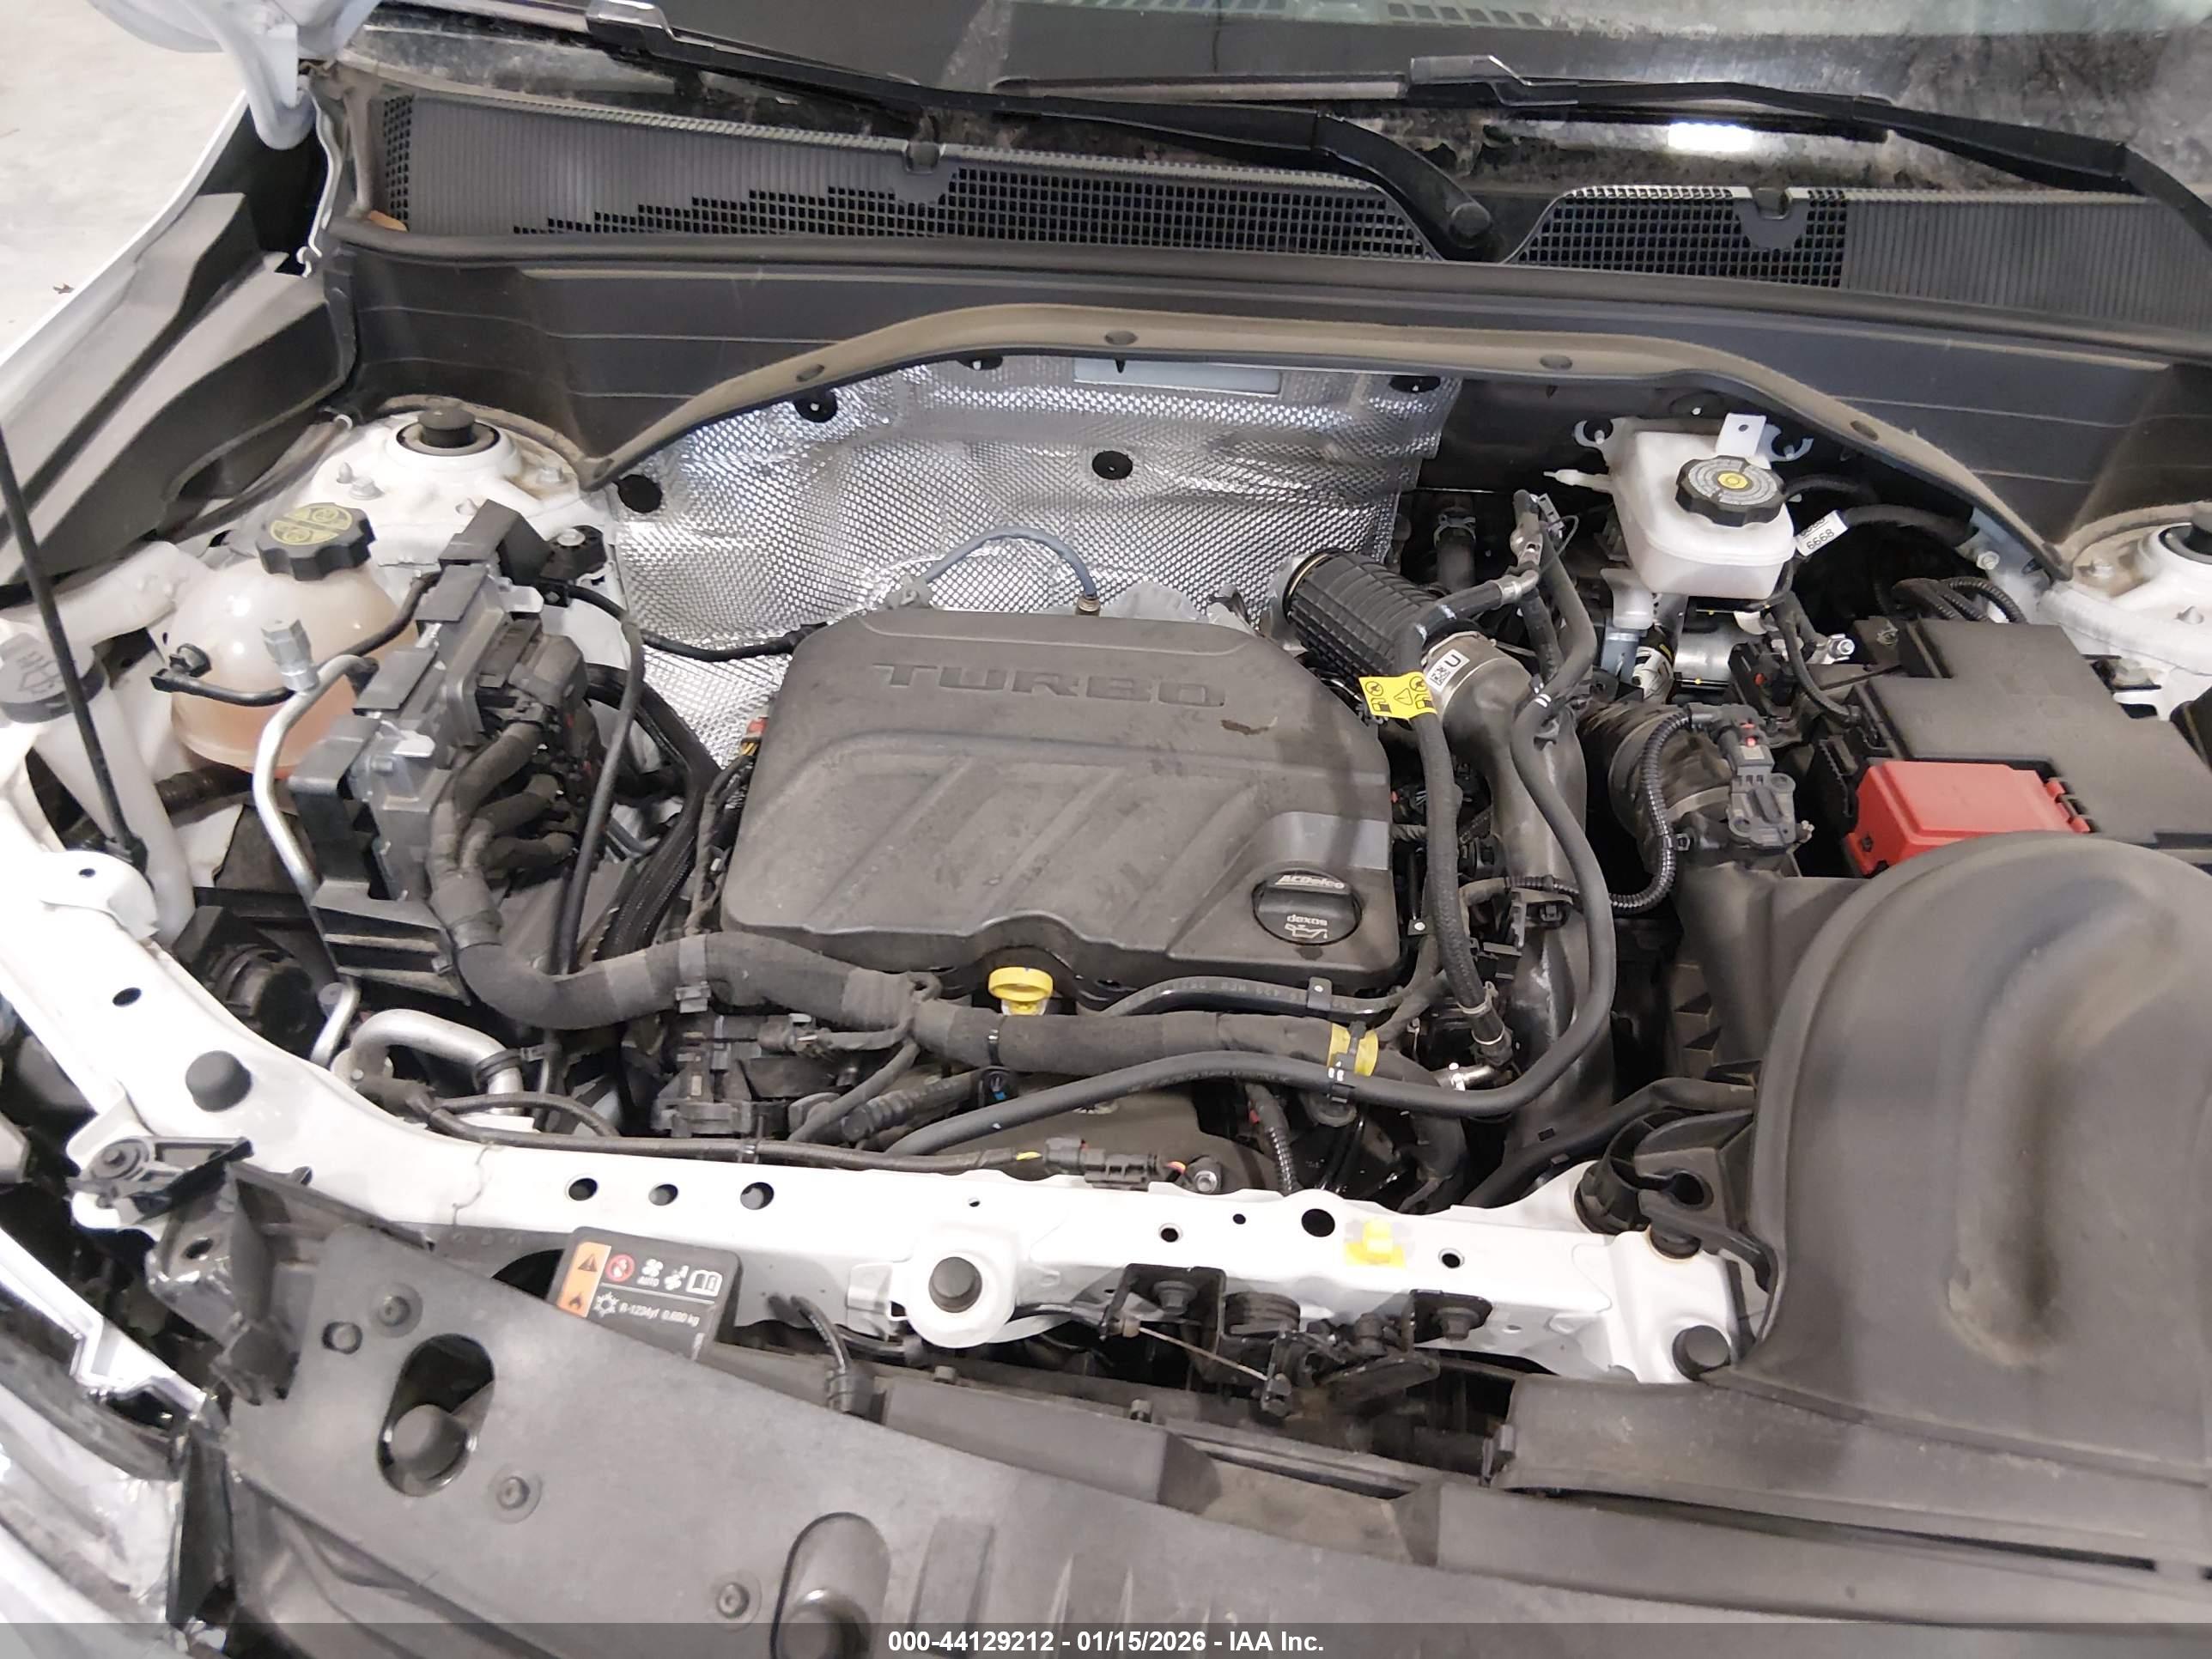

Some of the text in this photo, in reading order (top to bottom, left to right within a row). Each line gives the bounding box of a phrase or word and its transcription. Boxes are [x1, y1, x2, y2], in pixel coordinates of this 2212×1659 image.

[1807, 529, 1834, 550] 6668
[872, 662, 1225, 707] TURBO
[1274, 875, 1346, 889] ACDelco
[1287, 915, 1328, 926] dexos
